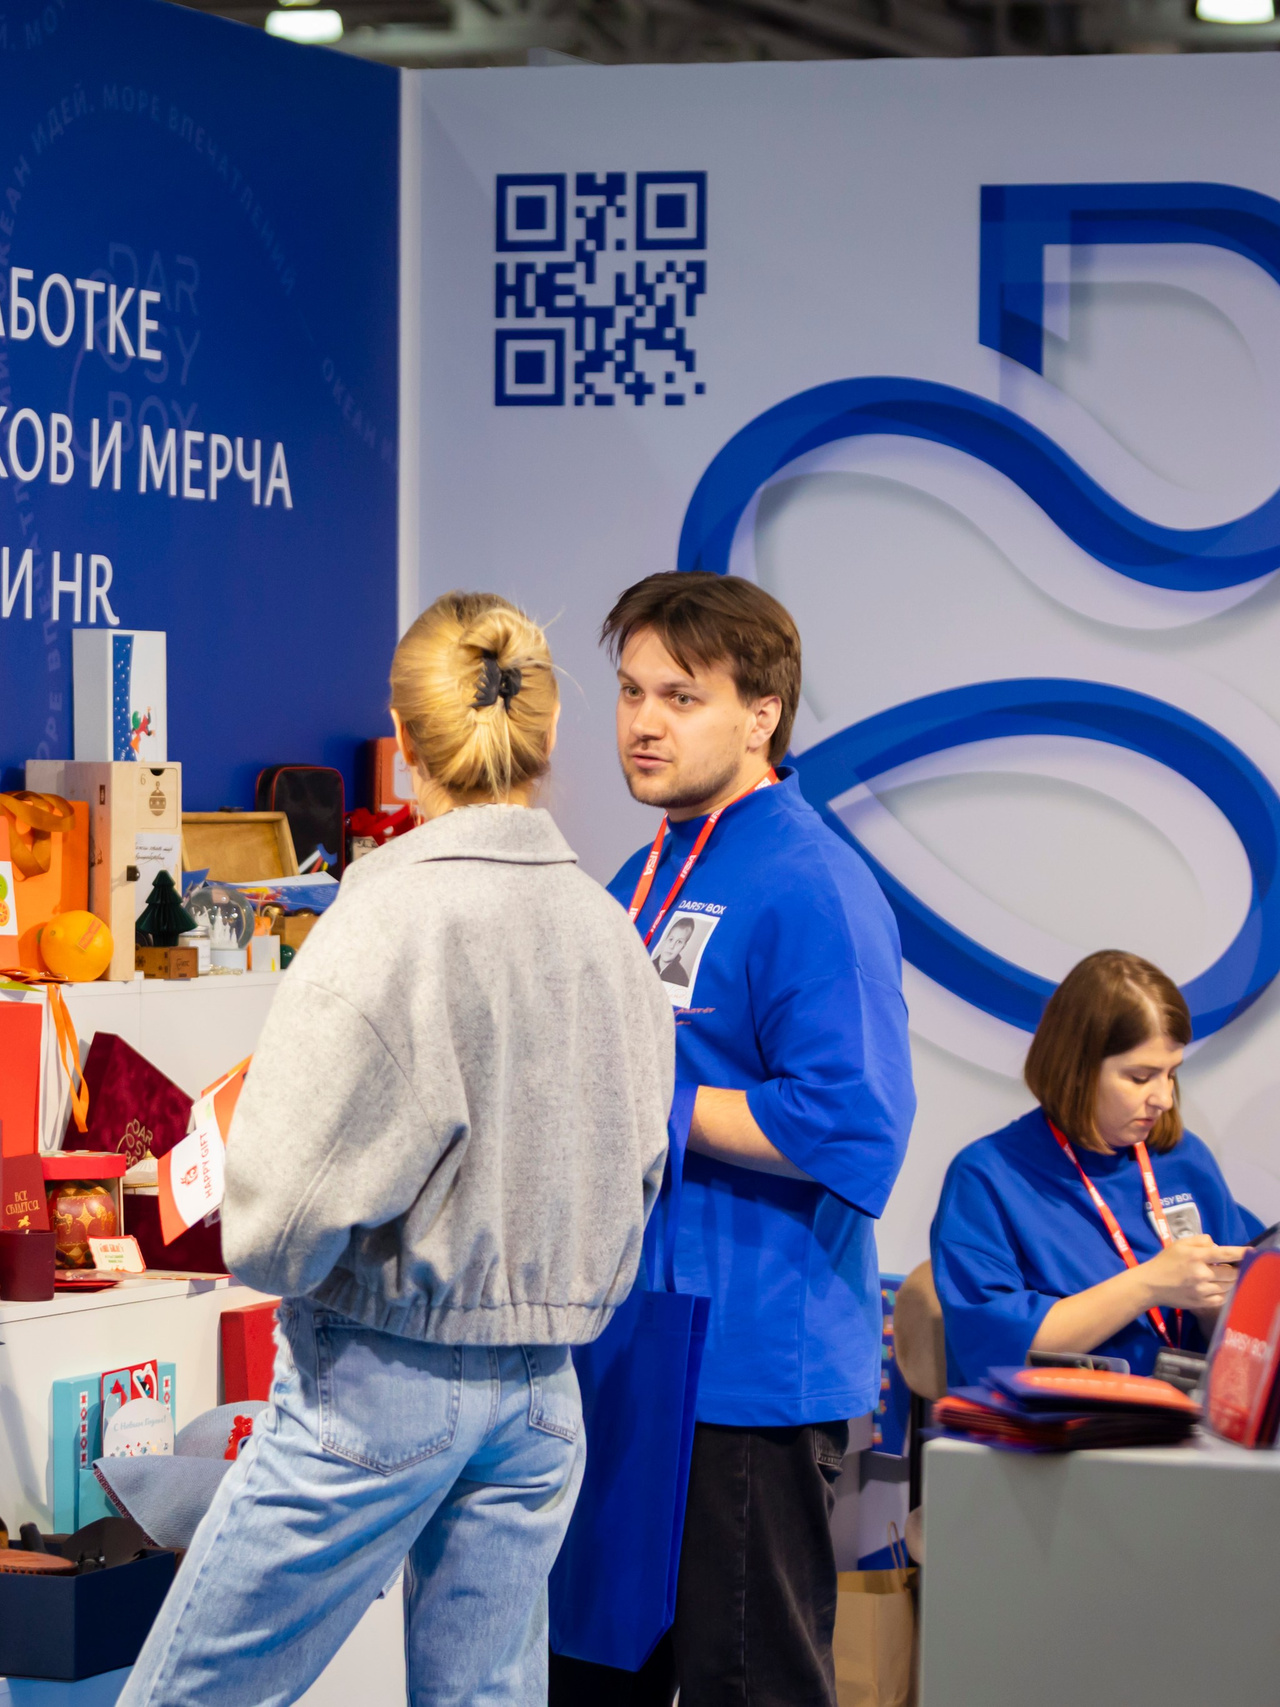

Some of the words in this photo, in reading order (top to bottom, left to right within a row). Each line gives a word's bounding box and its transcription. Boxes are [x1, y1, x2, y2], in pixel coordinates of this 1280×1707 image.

[91, 418, 122, 490] И
[139, 424, 293, 509] МЕРЧА
[1, 546, 33, 620] И
[51, 550, 121, 626] HR
[680, 854, 697, 879] IFSA
[678, 900, 706, 910] DARSY
[706, 903, 727, 916] BOX
[200, 1132, 210, 1158] GIFT
[202, 1160, 213, 1199] HAPPY
[1175, 1193, 1194, 1203] BOX
